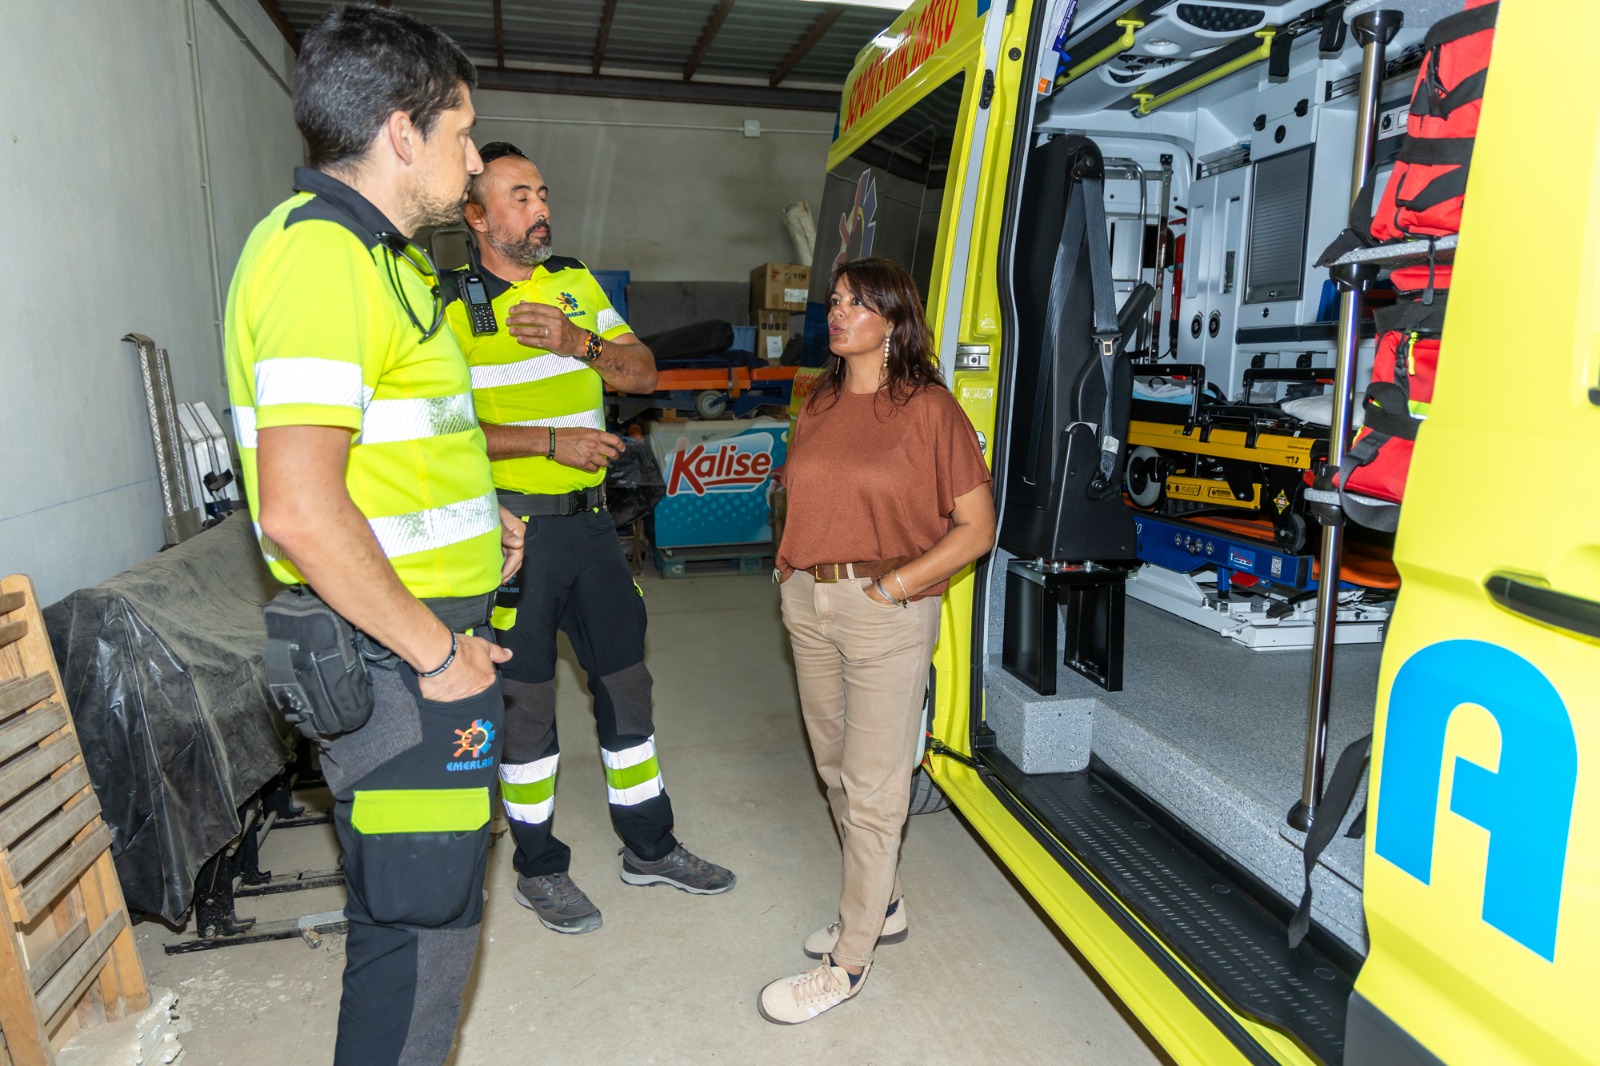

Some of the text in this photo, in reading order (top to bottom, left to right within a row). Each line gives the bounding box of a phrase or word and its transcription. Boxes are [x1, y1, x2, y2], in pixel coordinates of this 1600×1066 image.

[668, 441, 771, 495] Kalise
[446, 757, 493, 771] EMERLAN
[1375, 639, 1578, 963] A
